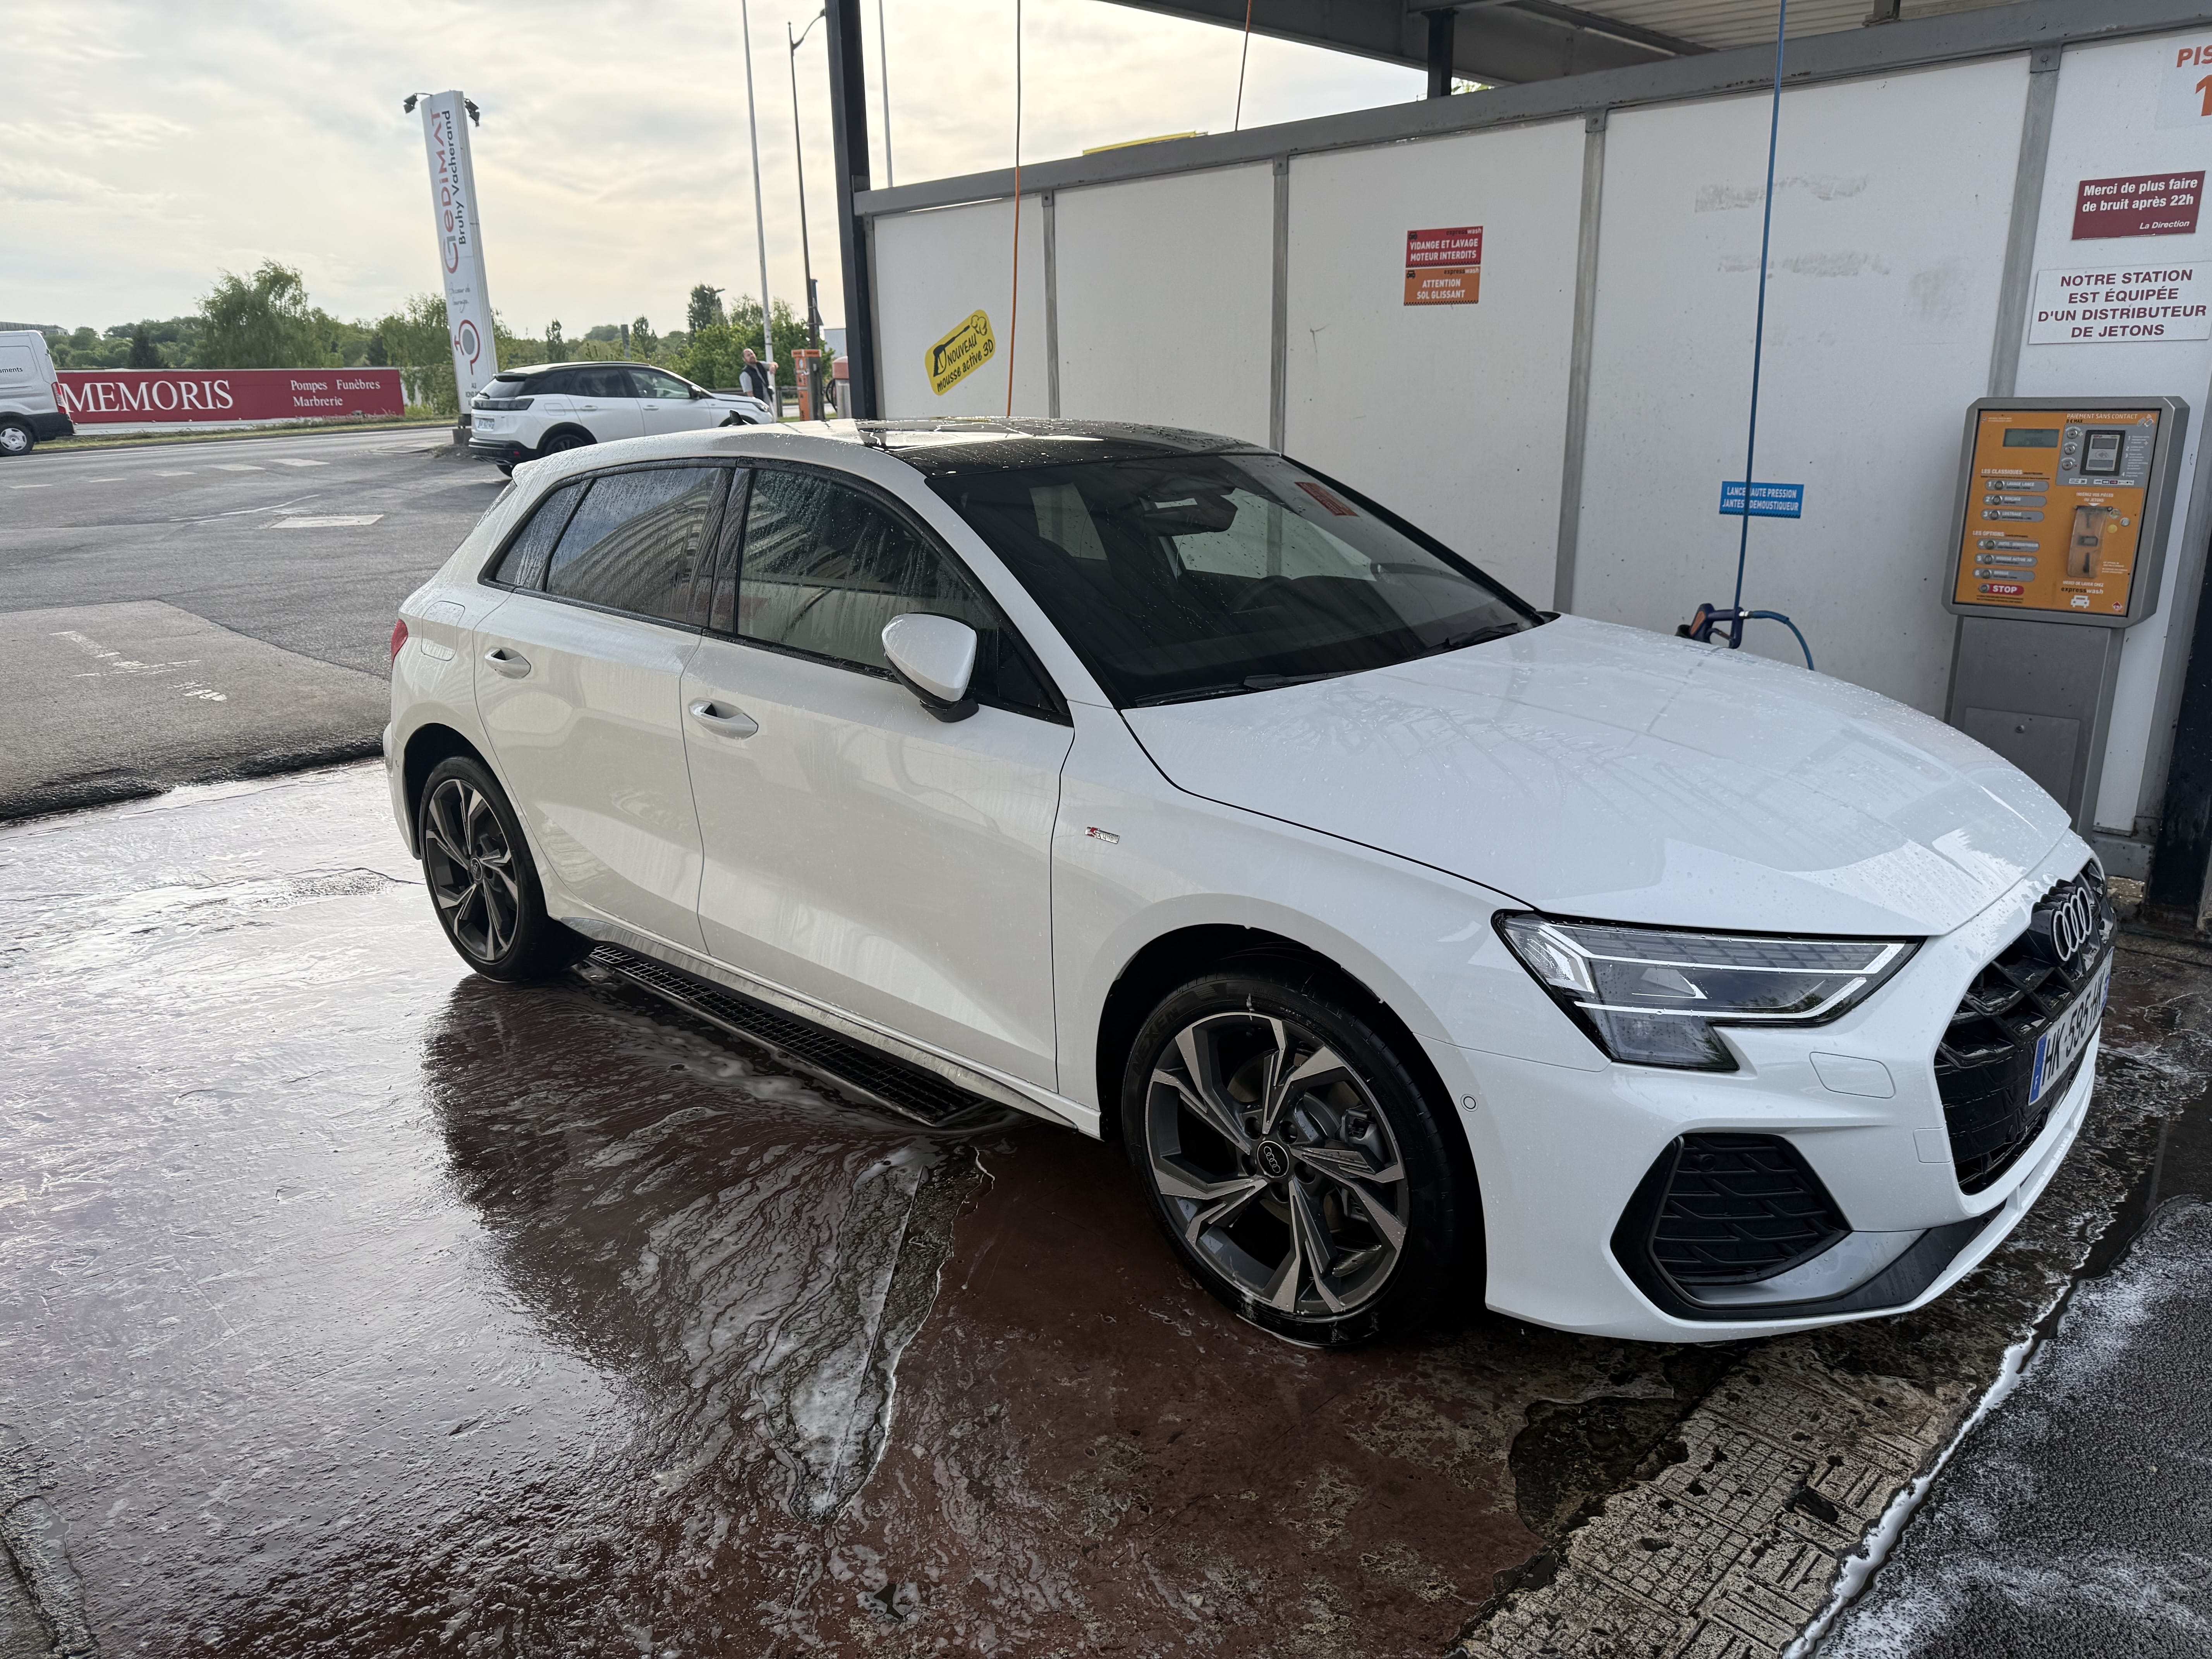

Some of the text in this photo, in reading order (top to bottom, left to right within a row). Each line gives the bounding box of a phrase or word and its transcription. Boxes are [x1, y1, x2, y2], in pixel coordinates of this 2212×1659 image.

[442, 110, 466, 244] Bruhy Vacherand
[2084, 178, 2198, 196] Merci de plus faire
[2083, 194, 2193, 212] de bruit après 22h
[1410, 239, 1478, 250] VIDANGE ET LAVAGE
[1410, 250, 1476, 261] MOTEUR INTERDITS
[1422, 278, 1461, 288] ATTENTION
[2061, 269, 2193, 287] NOTRE STATION
[1417, 290, 1465, 299] SOL GLISSANT
[2068, 286, 2179, 304] EST ÉQUIPÉE
[2038, 305, 2206, 322] D'UN DISTRIBUTEUR
[2071, 325, 2164, 338] DE JETONS
[947, 333, 977, 366] NOUVEAU
[937, 339, 994, 392] mousse active 3D
[291, 379, 380, 392] Pompes Funèbres
[59, 379, 233, 413] MEMORIS
[293, 396, 343, 407] Marbrerie
[1727, 487, 1797, 498] LANCE AUTE PRESSION
[1723, 499, 1745, 508] JANTES
[1992, 585, 2017, 593] STOP
